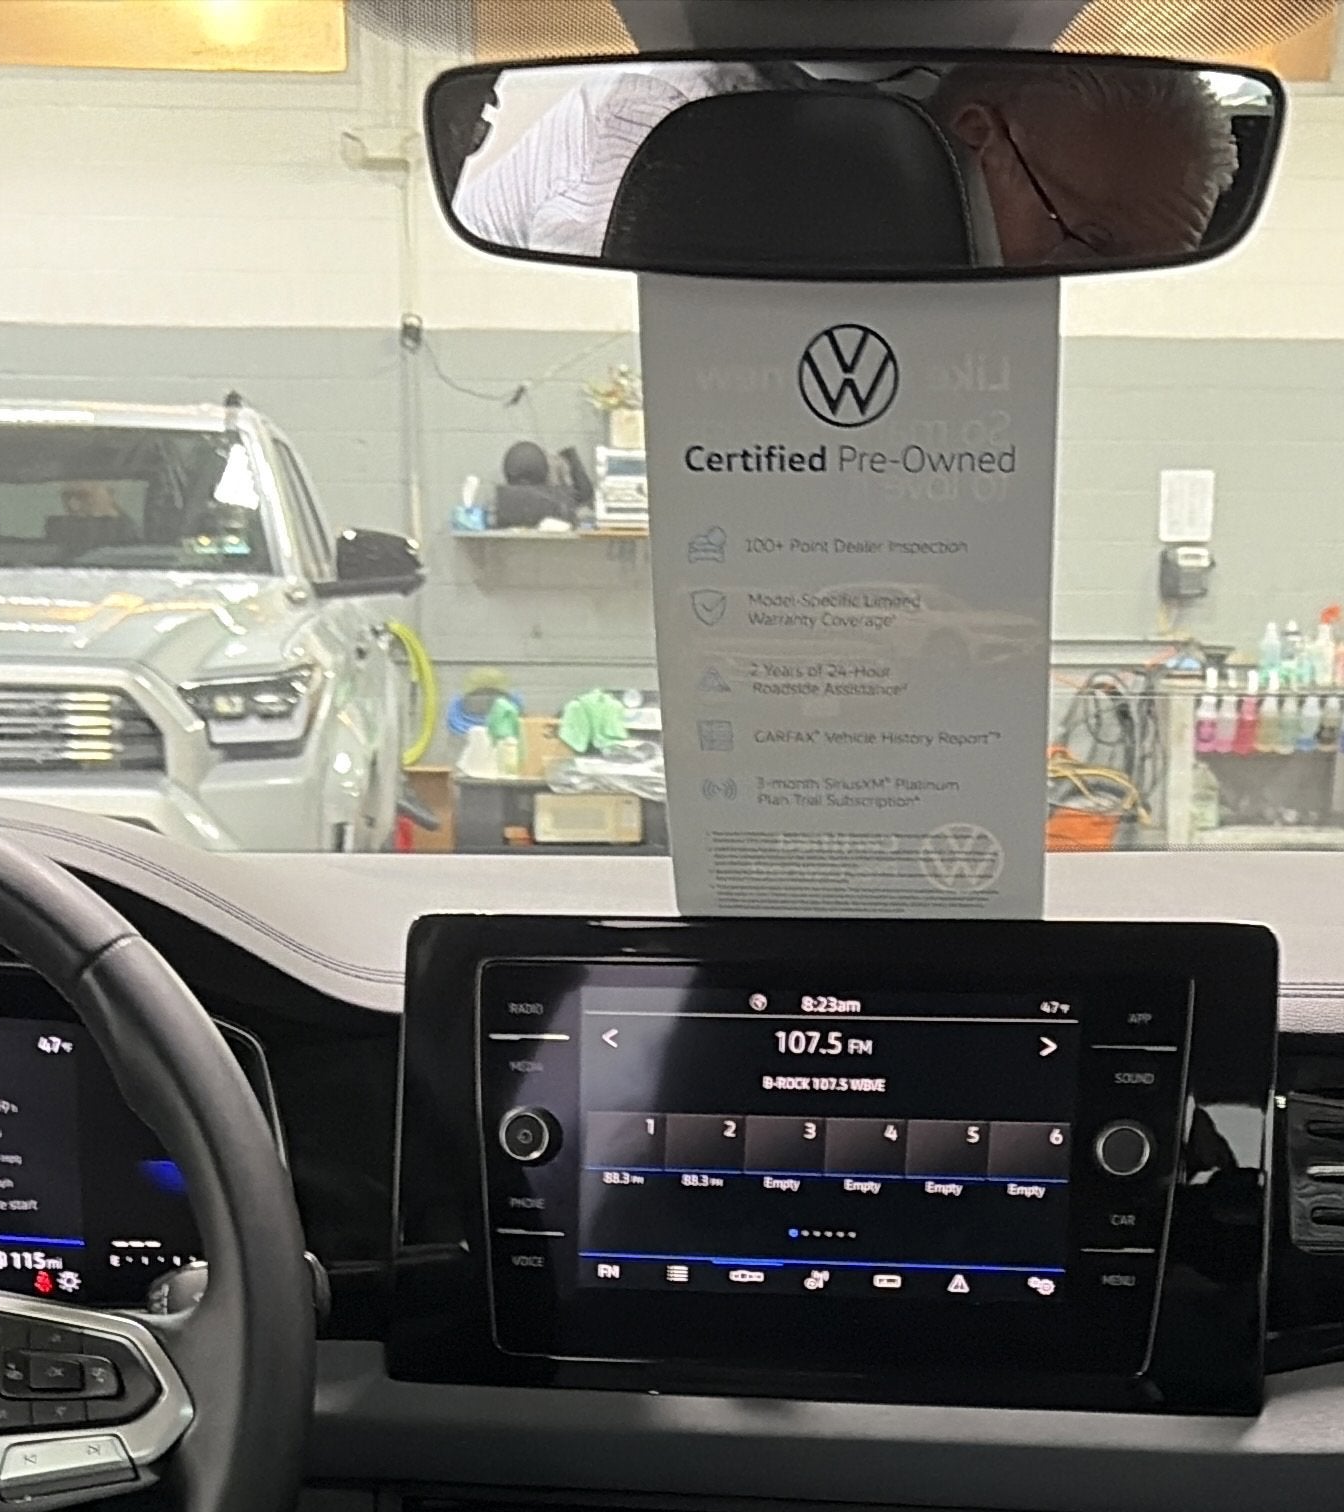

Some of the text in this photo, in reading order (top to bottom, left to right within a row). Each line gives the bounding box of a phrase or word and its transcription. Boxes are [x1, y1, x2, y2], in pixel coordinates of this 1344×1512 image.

[684, 444, 1017, 475] Certified Pre-Owned
[788, 539, 828, 554] Point
[834, 539, 882, 554] Dealer
[748, 612, 816, 629] Warranty
[763, 664, 803, 678] Years
[808, 664, 823, 678] of
[828, 665, 891, 678] 24-Hour
[752, 682, 818, 696] Roadside
[825, 731, 876, 744] Vehicle
[881, 732, 933, 747] History
[756, 776, 820, 790] 3-month
[895, 778, 959, 792] Platinum
[757, 793, 790, 806] Plan
[794, 793, 822, 806] Trial
[507, 1002, 544, 1016] RADIO
[801, 996, 861, 1013] 8:23am
[775, 1031, 873, 1055] 107.5 FM
[508, 1060, 544, 1073] MEDIA
[762, 1076, 811, 1091] B-ROCK
[812, 1077, 849, 1091] 107.5
[1114, 1072, 1155, 1085] SOUND
[645, 1117, 656, 1136] 1
[722, 1120, 737, 1138] 2
[803, 1122, 818, 1140] 3
[883, 1124, 899, 1142] 4
[966, 1126, 981, 1143] 5
[1049, 1128, 1064, 1145] 6
[763, 1175, 801, 1192] Empty
[843, 1178, 882, 1195] Empty
[924, 1180, 964, 1197] Empty
[1006, 1182, 1047, 1199] Empty
[8, 1199, 39, 1211] start
[508, 1197, 545, 1210] PHONE
[1109, 1213, 1136, 1226] CAR
[510, 1255, 544, 1268] VOICE
